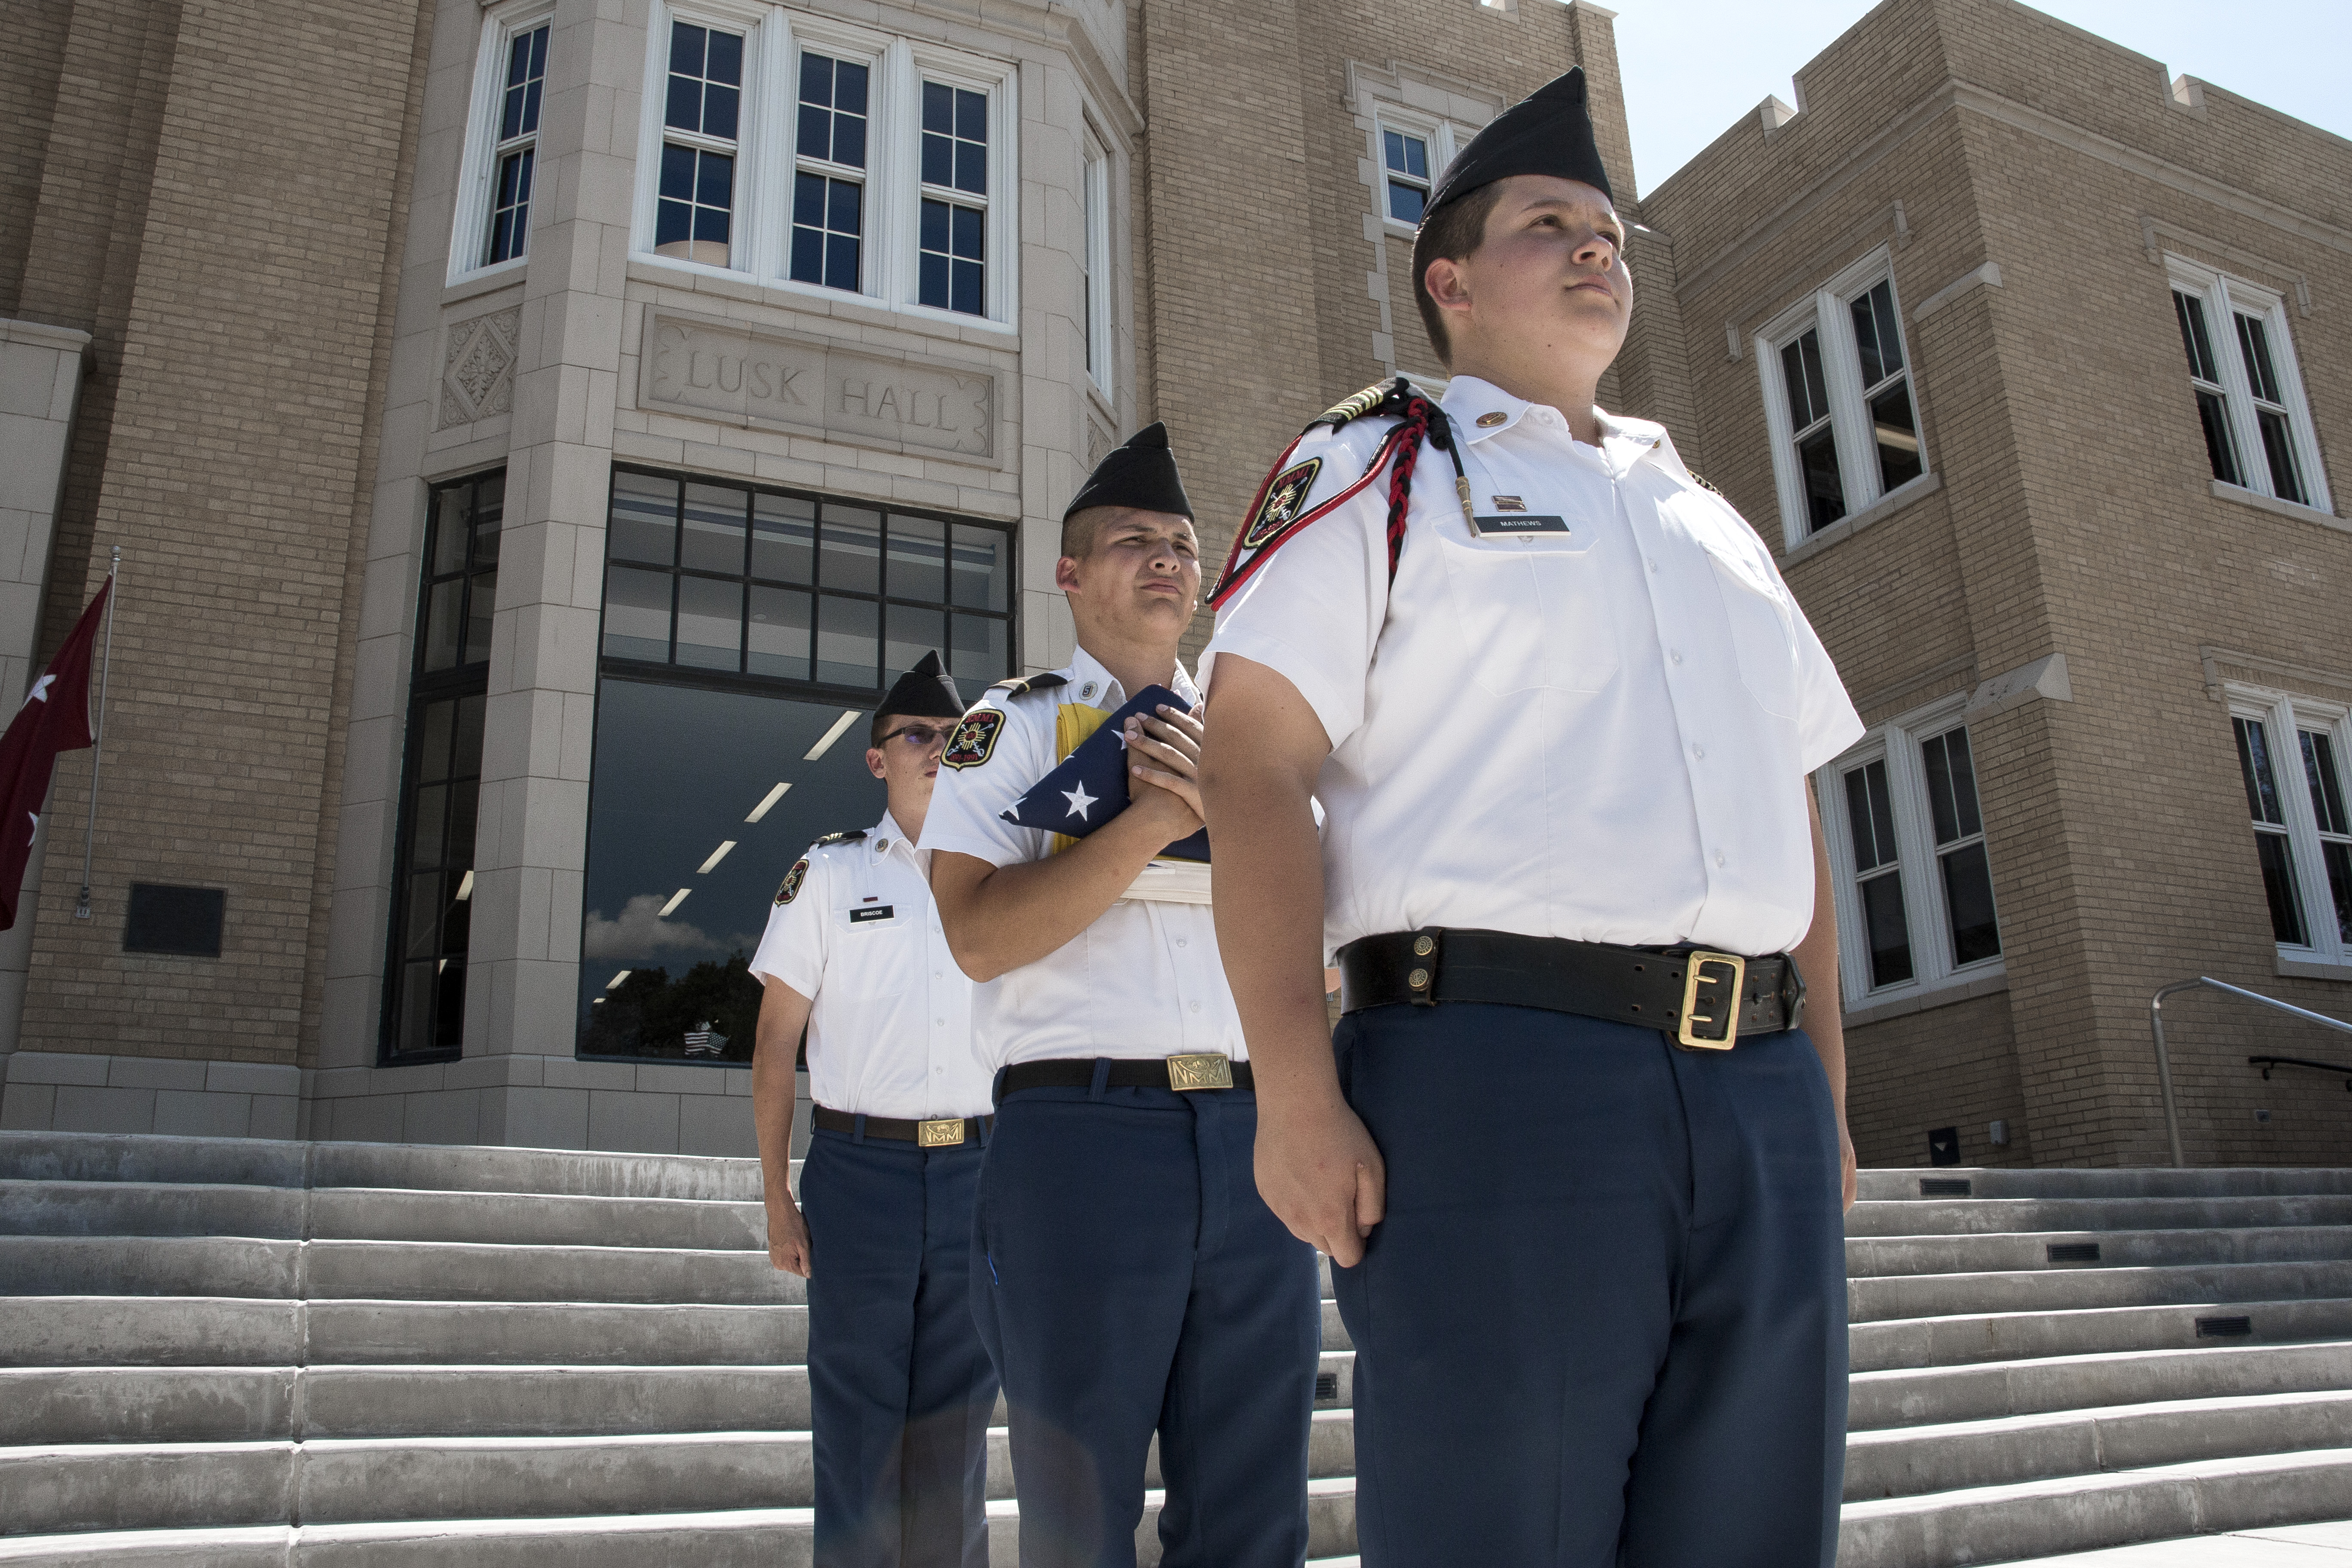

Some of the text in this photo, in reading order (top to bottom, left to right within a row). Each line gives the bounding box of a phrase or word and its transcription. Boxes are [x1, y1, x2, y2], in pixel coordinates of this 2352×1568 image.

[685, 350, 958, 432] LUSK HALL
[1275, 466, 1310, 490] NMMI
[965, 713, 996, 723] NMMI
[1172, 1058, 1229, 1084] NMMI
[922, 1123, 962, 1142] NMMI
